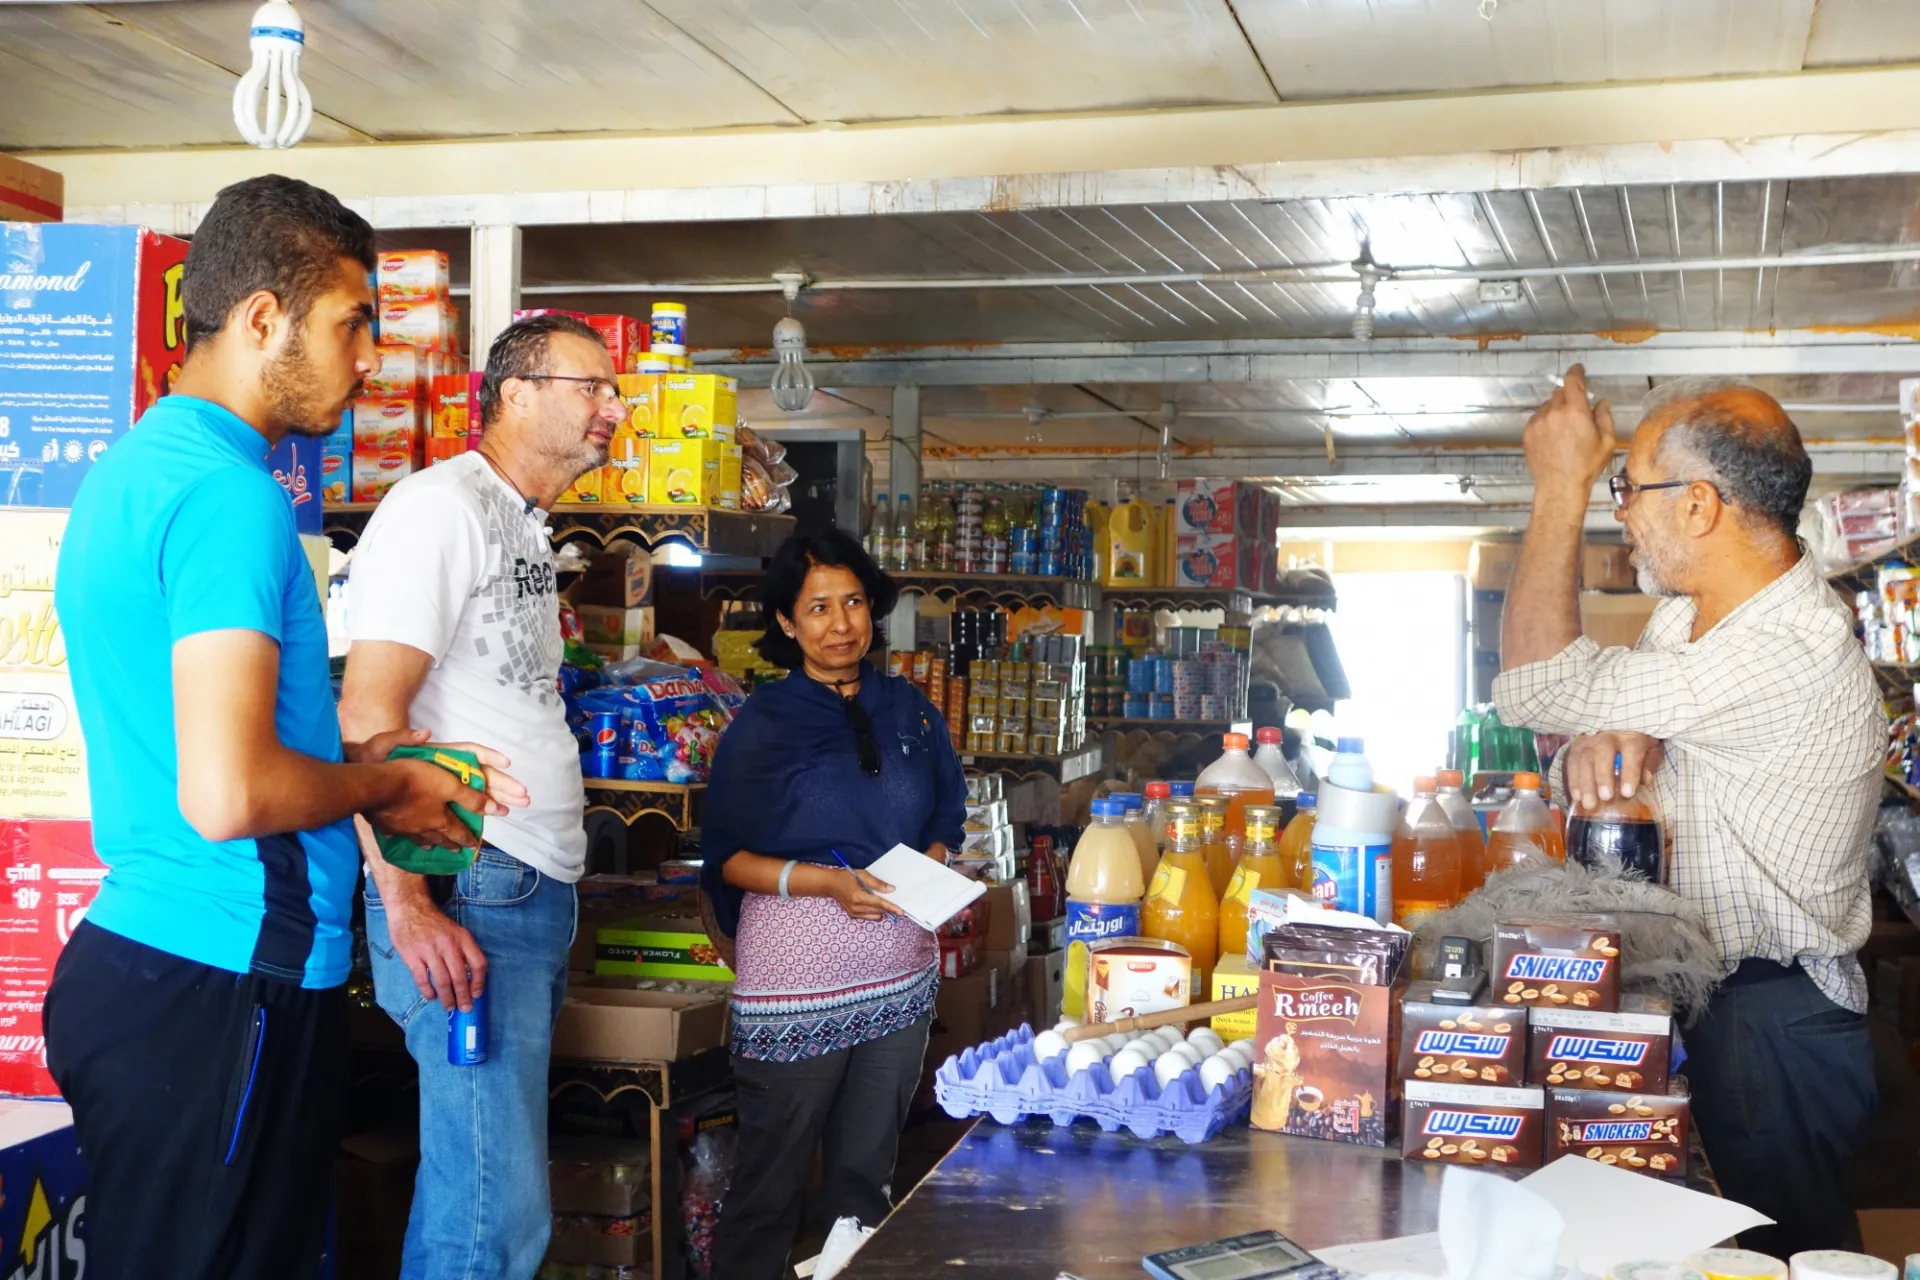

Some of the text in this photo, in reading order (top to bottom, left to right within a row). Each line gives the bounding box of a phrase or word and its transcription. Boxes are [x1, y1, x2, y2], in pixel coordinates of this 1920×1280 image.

[1510, 955, 1603, 982] SNICKERS
[1273, 993, 1360, 1017] Rmeeh
[1300, 992, 1335, 1004] Coffee
[1363, 1036, 1382, 1045] قهوة
[1585, 1123, 1650, 1140] SNICKERS
